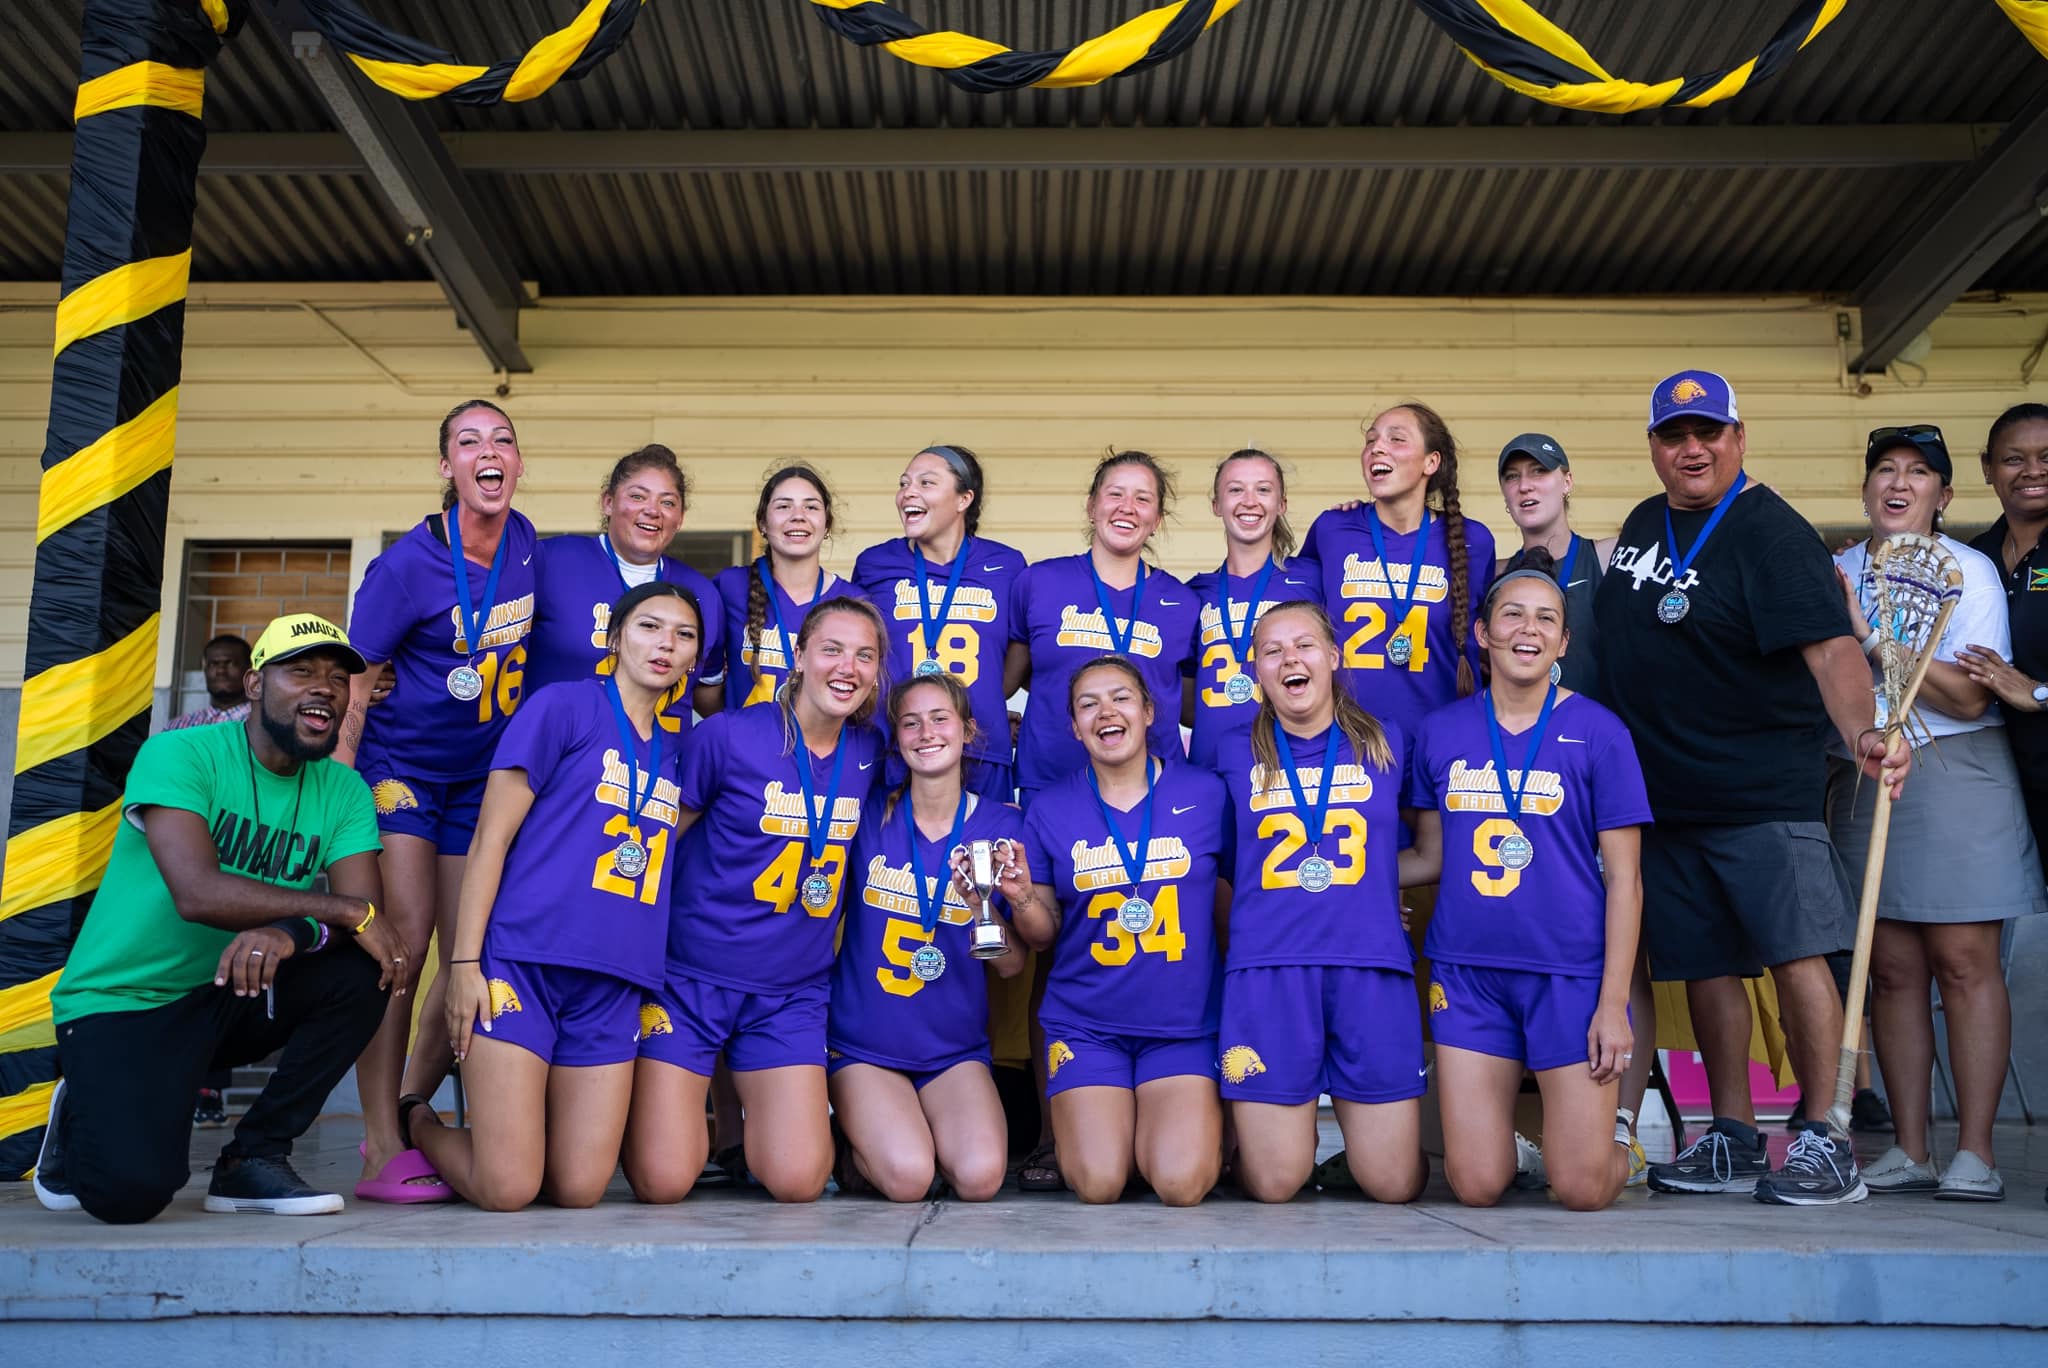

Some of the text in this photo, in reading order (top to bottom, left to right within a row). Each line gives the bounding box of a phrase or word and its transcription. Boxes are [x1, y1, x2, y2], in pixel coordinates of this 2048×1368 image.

[291, 621, 340, 640] JAMAICA
[907, 622, 980, 688] 18
[1342, 602, 1430, 672] 24
[477, 644, 527, 723] 16
[1202, 643, 1264, 707] 3
[592, 813, 669, 906] 21
[752, 841, 846, 919] 43
[1257, 808, 1368, 890] 23
[1471, 818, 1524, 898] 9
[876, 917, 936, 997] 5
[1088, 884, 1187, 966] 34
